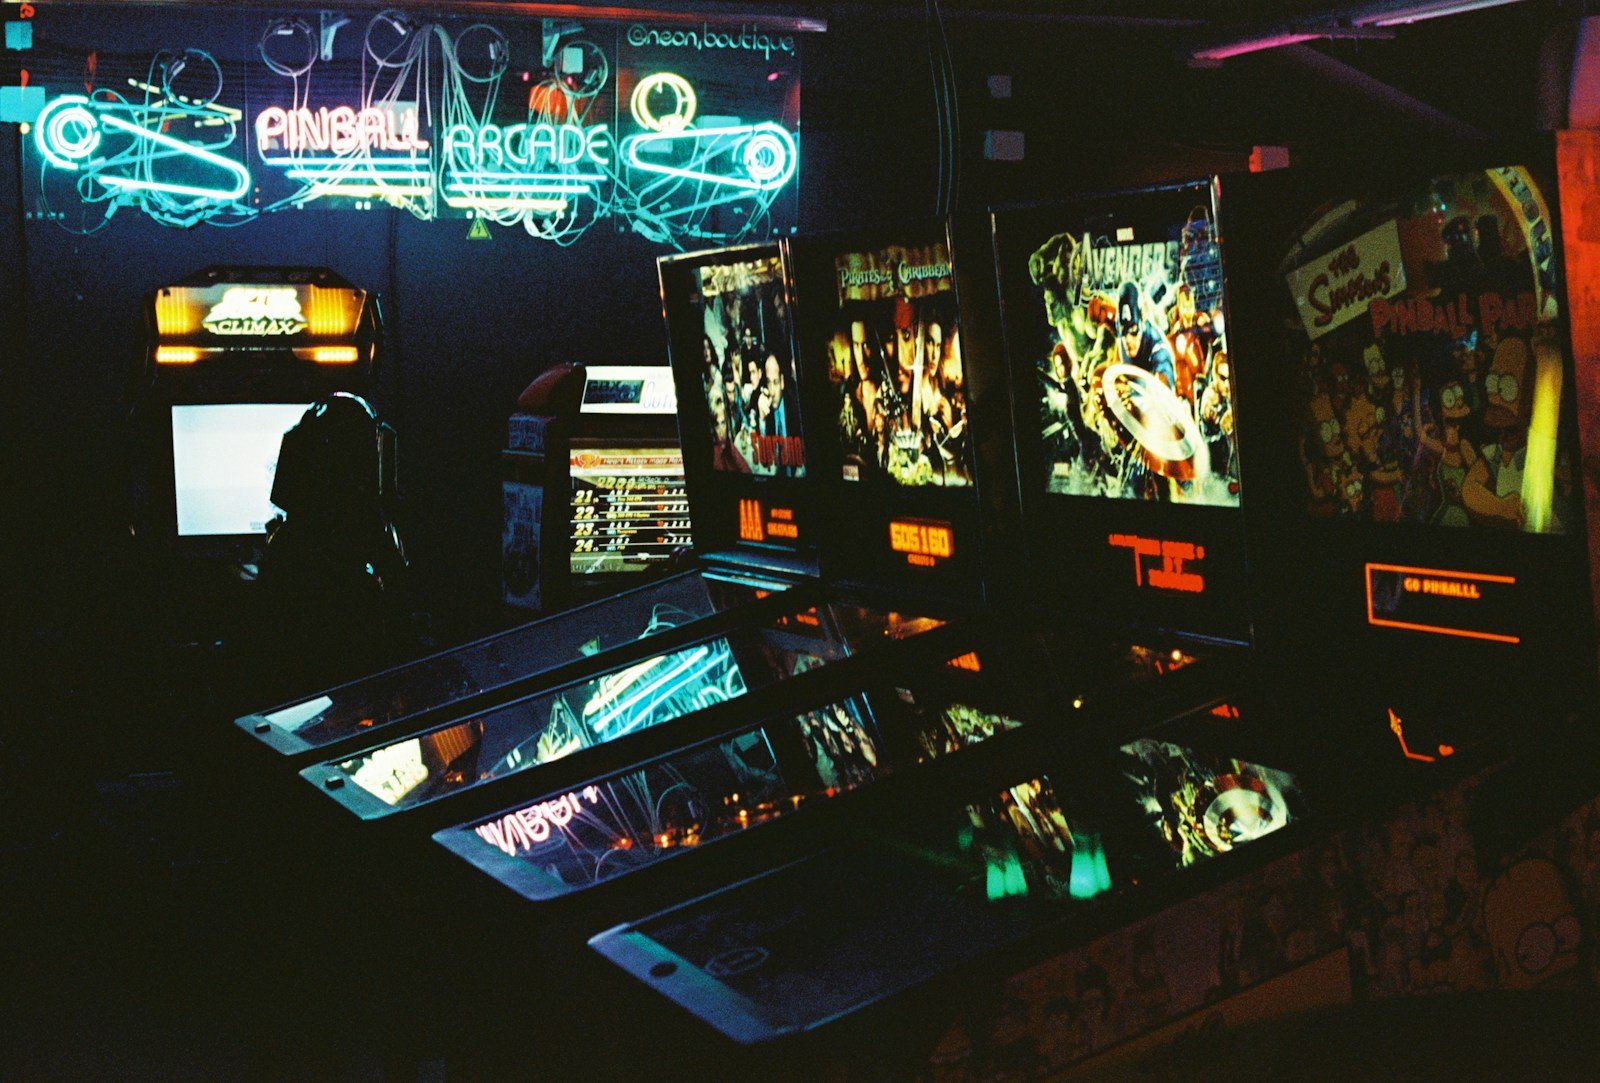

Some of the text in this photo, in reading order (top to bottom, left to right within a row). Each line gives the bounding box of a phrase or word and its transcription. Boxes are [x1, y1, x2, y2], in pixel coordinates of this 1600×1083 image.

[256, 106, 608, 165] PINBALL ARCADE
[898, 260, 952, 284] CARIBBEAN
[1071, 232, 1181, 294] AVENGERS
[219, 319, 296, 336] CLIMAX
[1368, 294, 1474, 338] PINBALL
